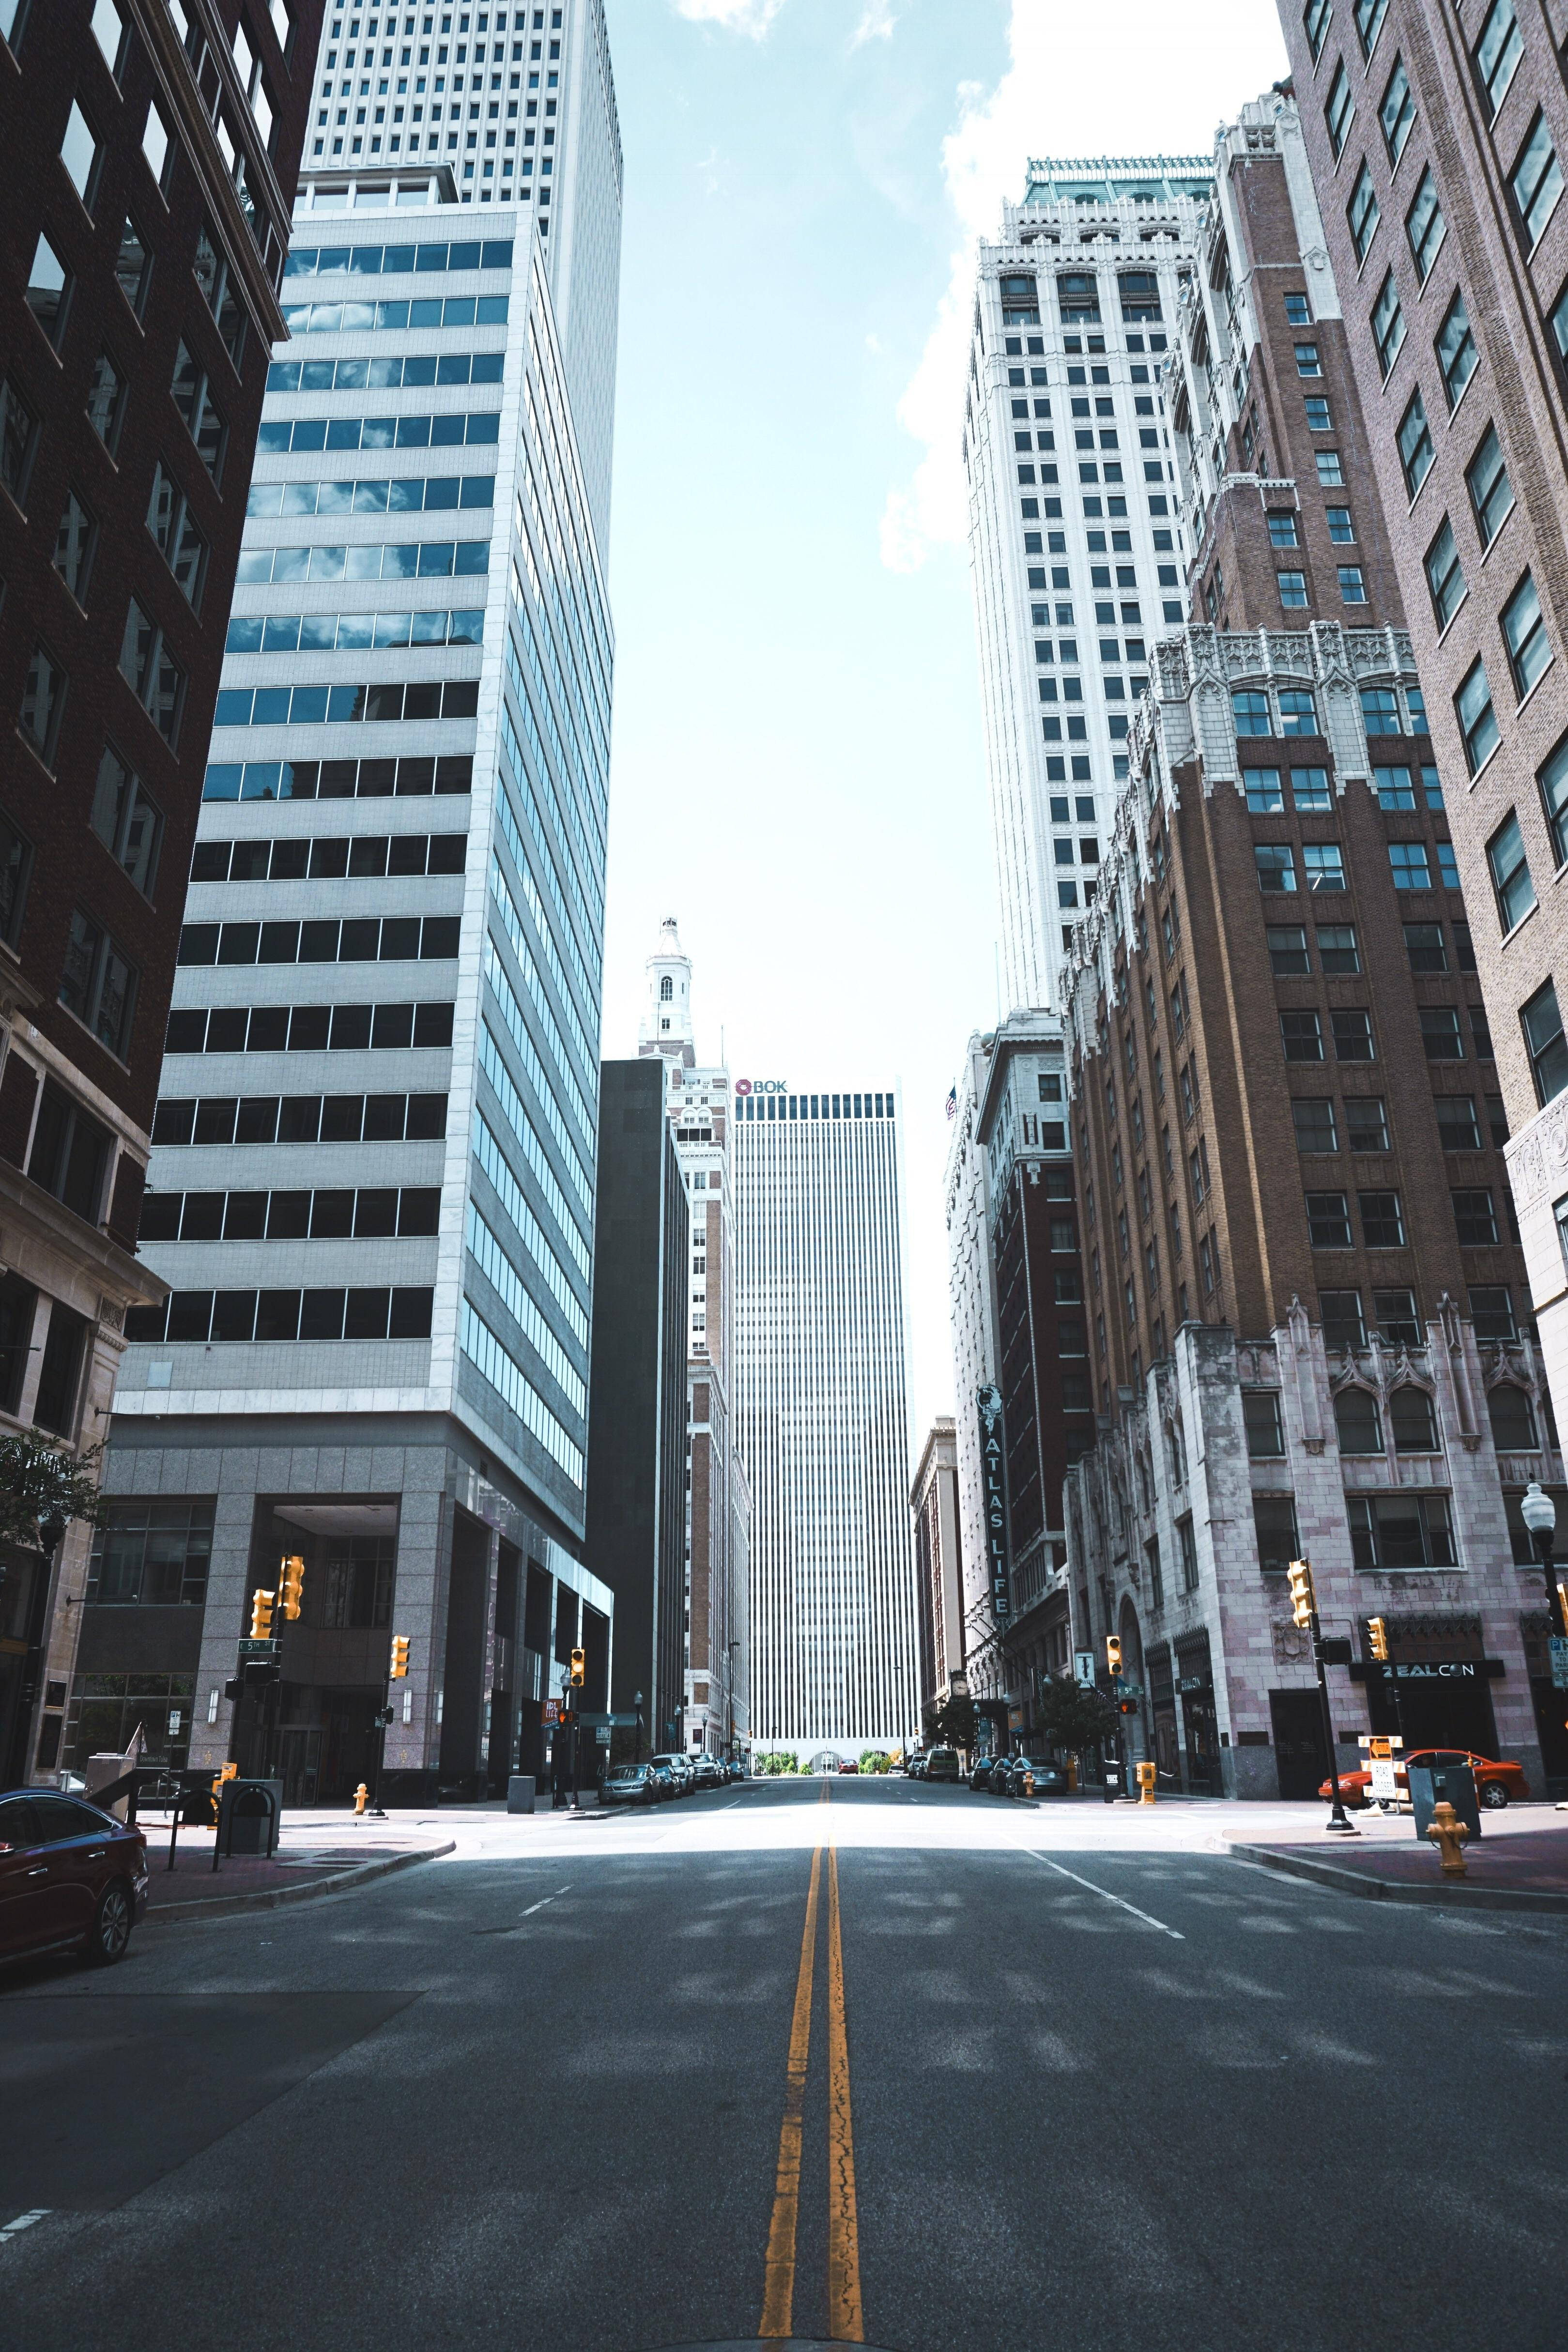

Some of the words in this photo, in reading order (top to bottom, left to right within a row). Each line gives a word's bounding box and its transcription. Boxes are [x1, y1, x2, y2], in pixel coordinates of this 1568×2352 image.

[753, 1080, 788, 1093] BOK
[985, 1438, 1003, 1528] ATLAS
[992, 1539, 1008, 1613] LIFE
[247, 1642, 260, 1650] 5TH
[1376, 1744, 1390, 1752] DETOUR
[1376, 1767, 1388, 1777] ROAD
[1375, 1781, 1393, 1792] CLOSED
